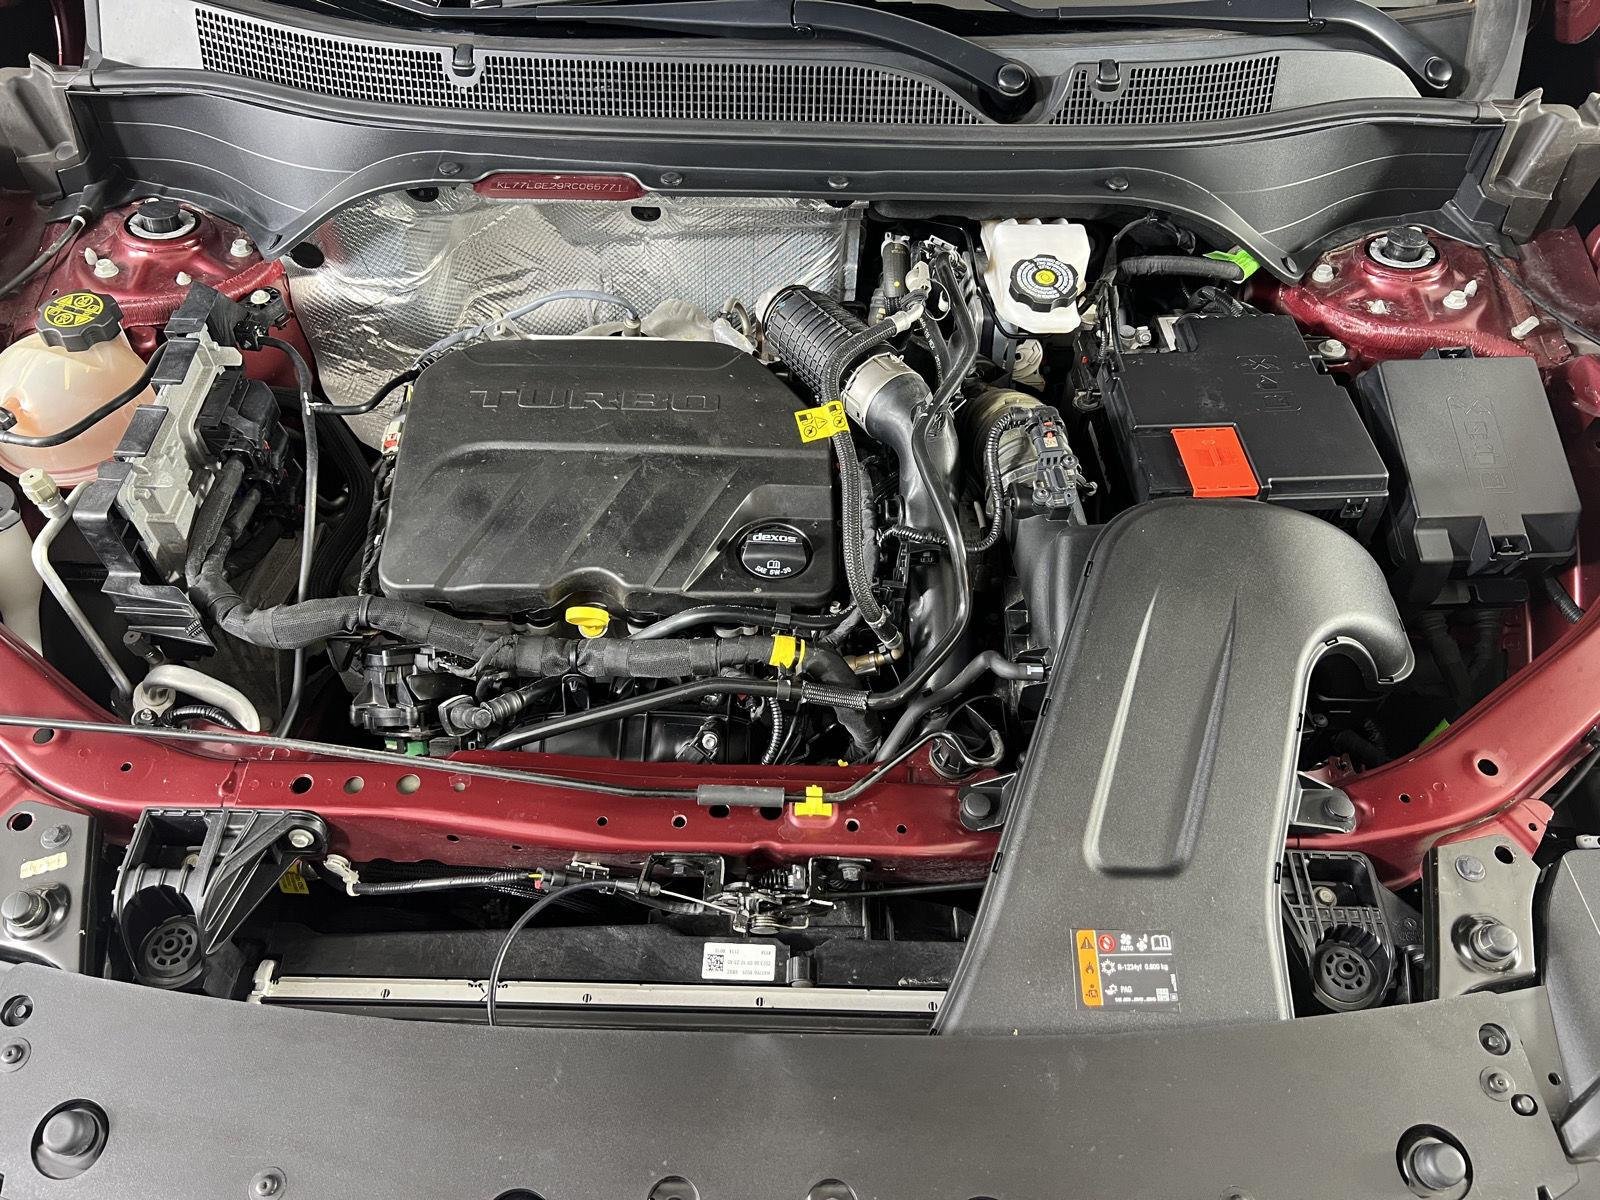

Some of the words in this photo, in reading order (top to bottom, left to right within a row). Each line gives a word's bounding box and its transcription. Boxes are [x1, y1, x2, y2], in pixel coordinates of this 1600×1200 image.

[470, 389, 721, 412] TURBO
[752, 532, 797, 543] dexos
[754, 565, 768, 575] SAE
[1120, 985, 1133, 993] PAG
